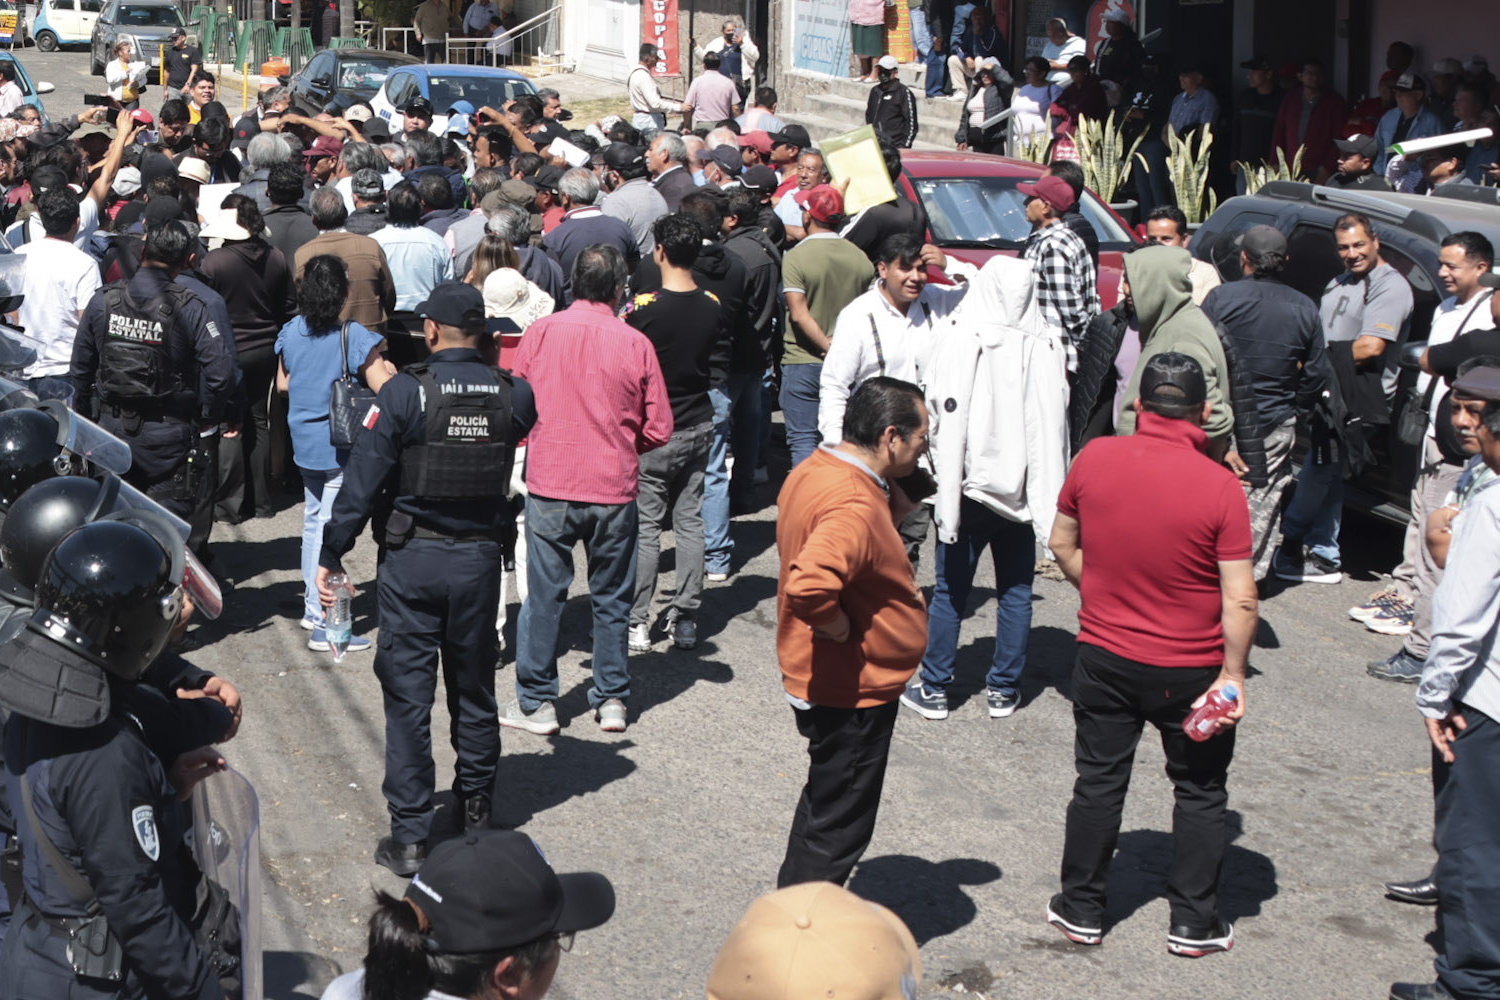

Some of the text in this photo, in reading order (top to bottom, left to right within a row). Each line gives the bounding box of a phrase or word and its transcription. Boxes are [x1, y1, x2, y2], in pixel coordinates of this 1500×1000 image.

[652, 0, 667, 73] COPIAS
[801, 32, 833, 65] COPIAS
[108, 323, 163, 342] ESTATAL
[109, 313, 164, 333] POLICIA
[449, 414, 489, 427] POLICÍA
[447, 426, 490, 437] ESTATAL
